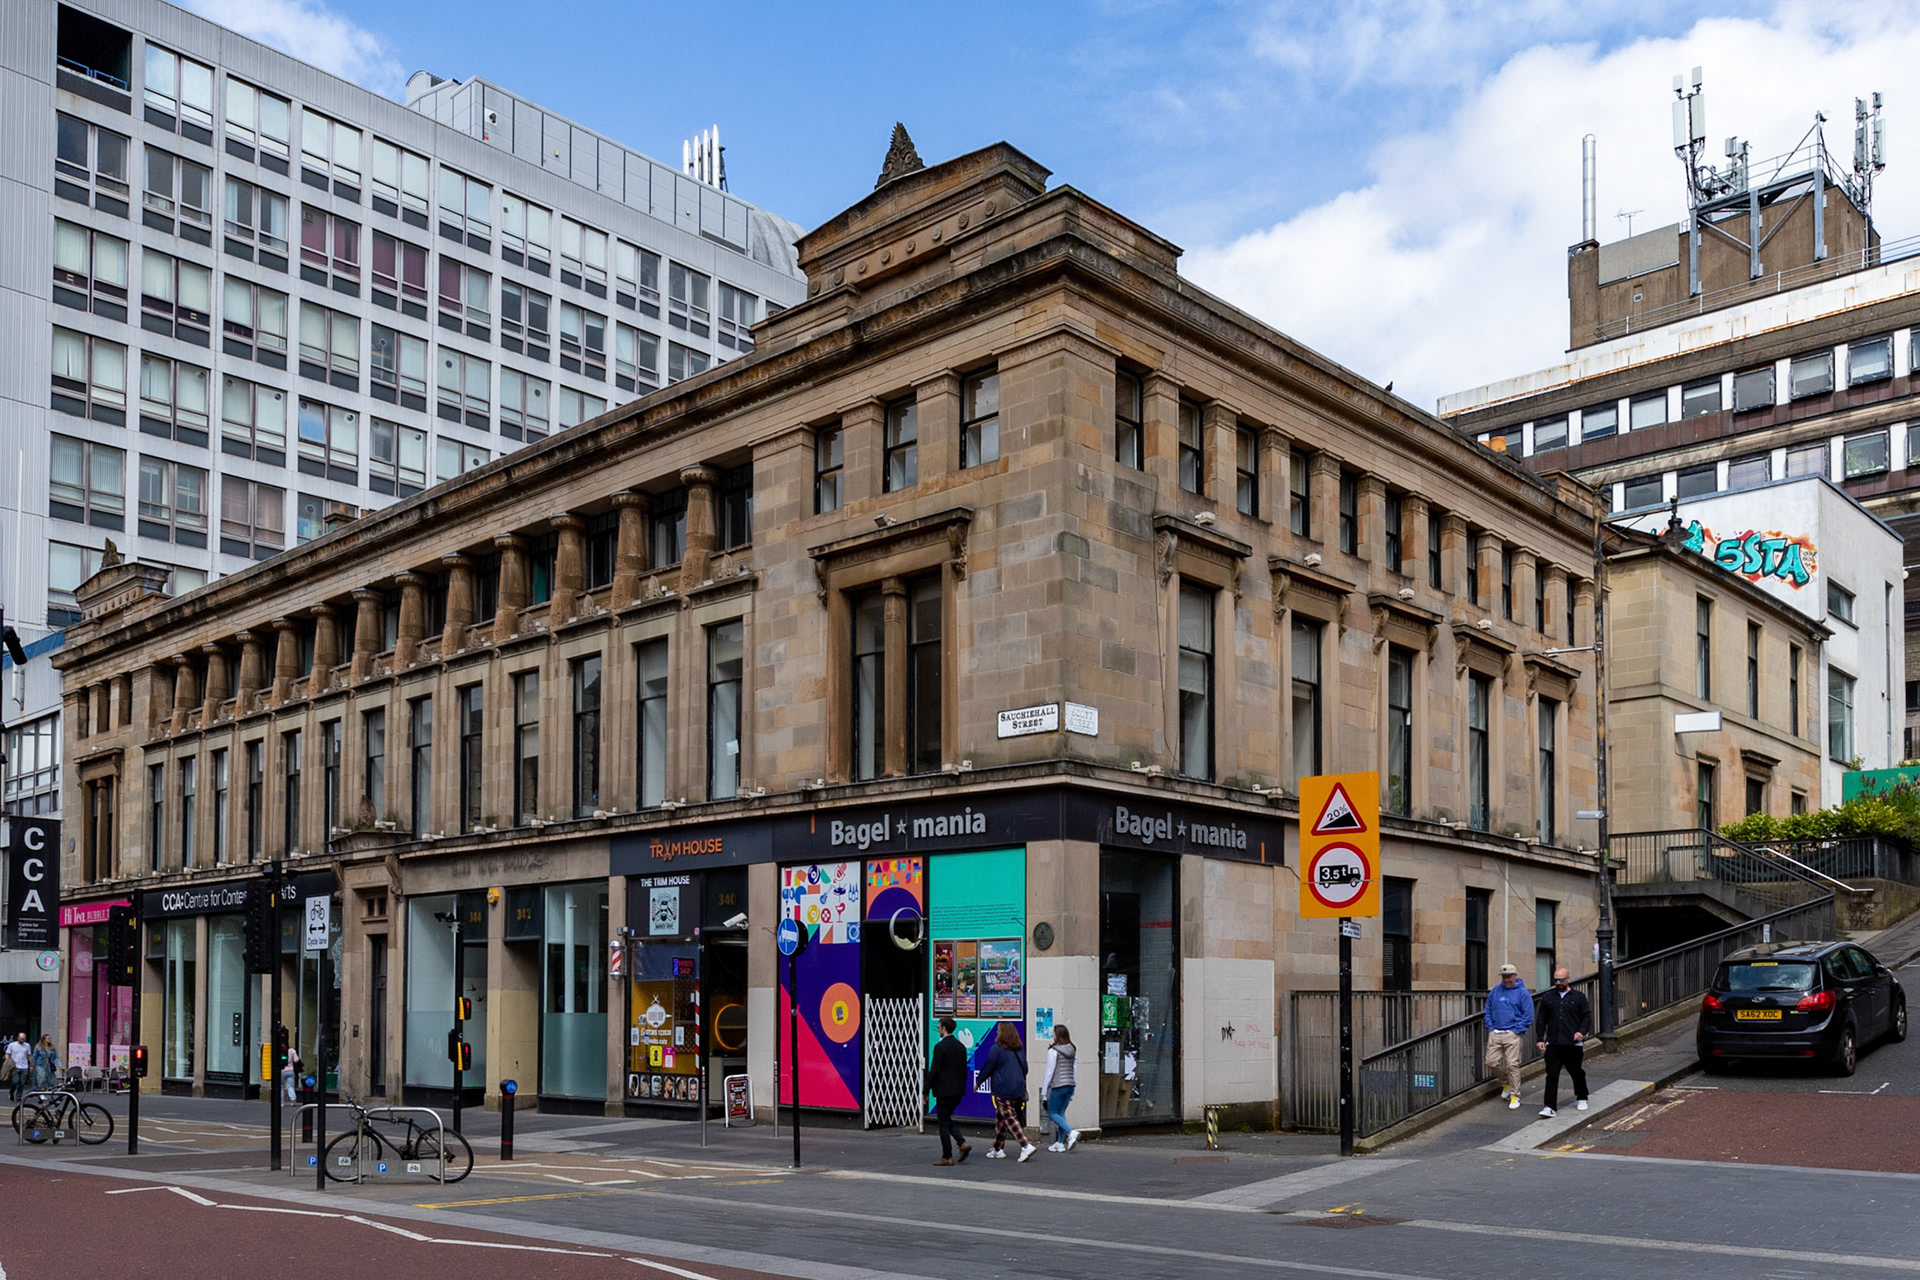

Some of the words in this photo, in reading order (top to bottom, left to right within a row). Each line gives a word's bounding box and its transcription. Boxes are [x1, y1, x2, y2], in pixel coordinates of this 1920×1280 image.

[1000, 707, 1055, 722] SAUCHIEHALL
[1012, 718, 1044, 729] STREET
[1326, 804, 1348, 822] 20%
[831, 814, 890, 850] Bagel
[913, 806, 986, 839] mania
[1116, 806, 1172, 844] Bagel
[1191, 822, 1247, 849] mania
[682, 838, 723, 855] HOUSE
[21, 827, 45, 913] CCA
[868, 859, 922, 873] SAUCHIE
[640, 878, 653, 887] THE
[653, 876, 668, 886] TRIM
[668, 874, 690, 885] HOUSE
[868, 873, 899, 886] HALL
[905, 872, 922, 884] ST
[210, 889, 221, 907] for
[64, 907, 72, 925] Hi
[517, 908, 531, 921] 342
[307, 937, 318, 947] Cycle
[319, 937, 327, 945] lane
[1762, 1010, 1778, 1018] XOC
